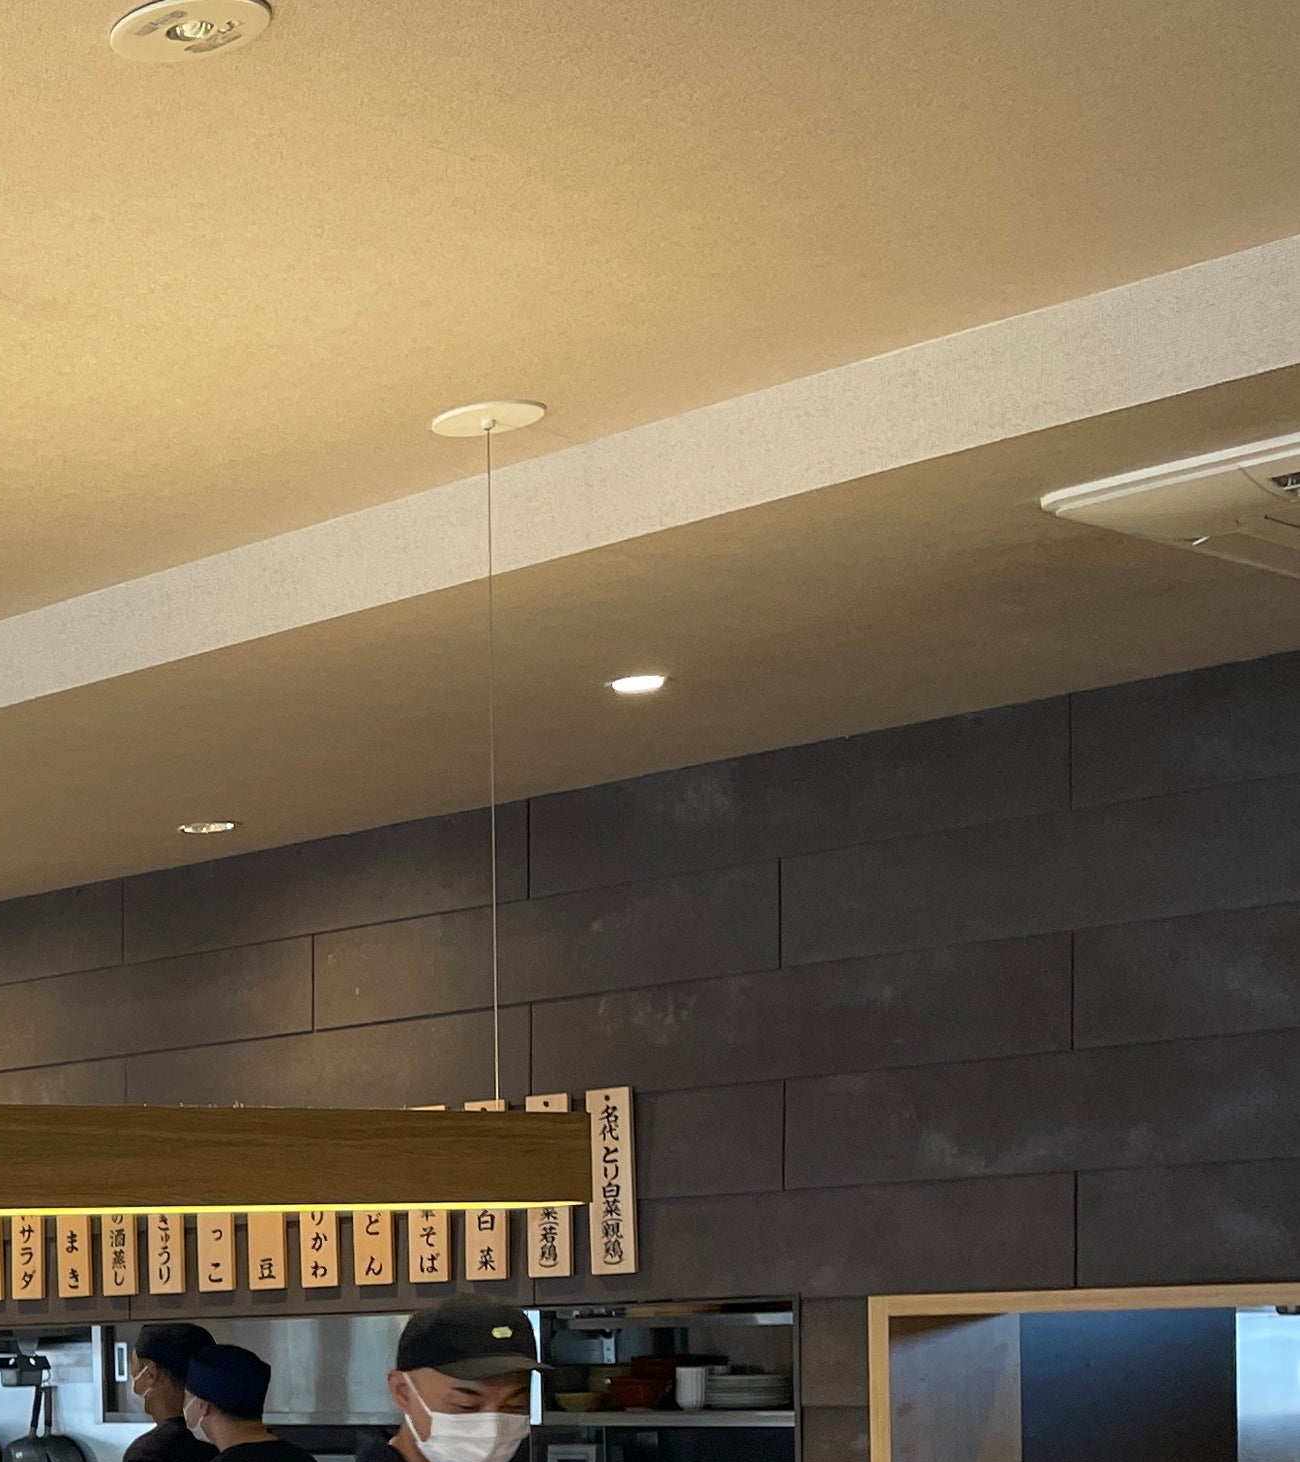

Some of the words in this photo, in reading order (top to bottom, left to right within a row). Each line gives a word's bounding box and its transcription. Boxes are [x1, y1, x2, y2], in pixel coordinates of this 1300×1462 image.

[65, 1230, 80, 1290] まき
[258, 1257, 277, 1281] 豆
[364, 1212, 383, 1277] どん
[477, 1210, 497, 1272] 白菜
